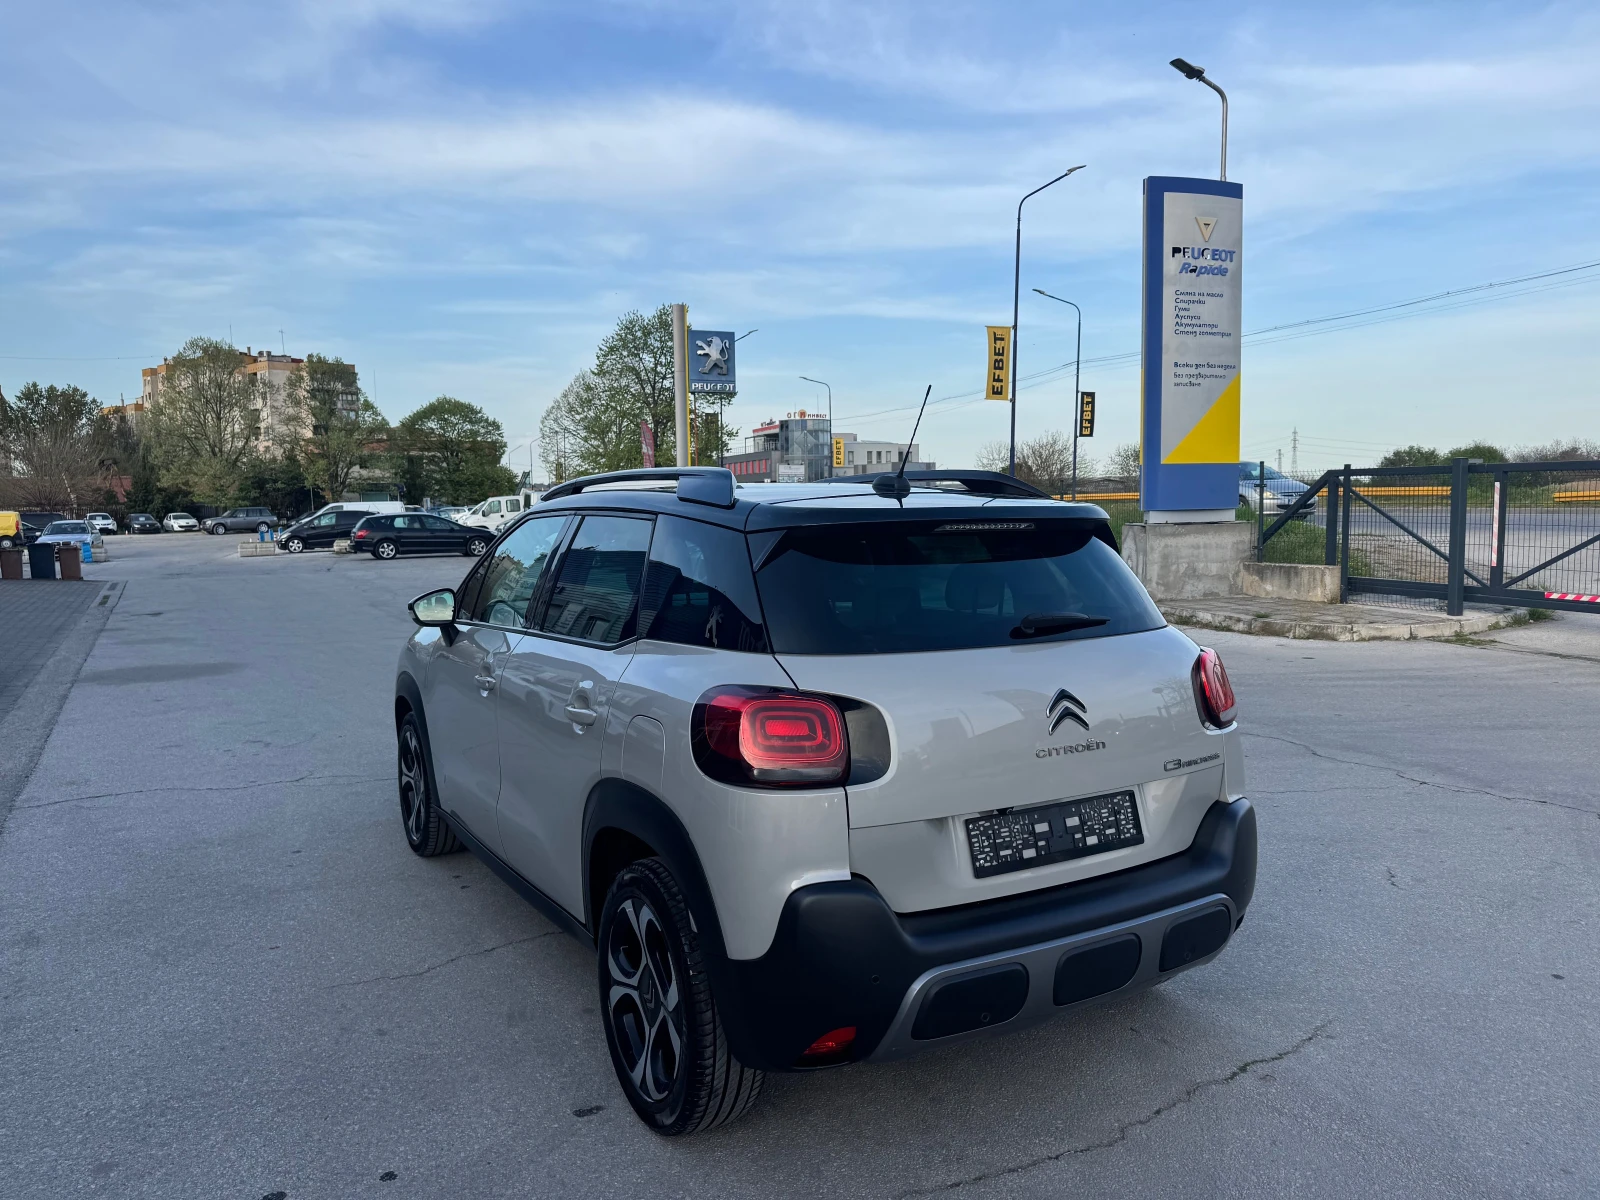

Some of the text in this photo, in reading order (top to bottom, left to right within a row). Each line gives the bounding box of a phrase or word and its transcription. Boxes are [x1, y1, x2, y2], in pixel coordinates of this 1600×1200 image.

[1171, 246, 1236, 262] PEUGEOT
[1178, 262, 1229, 277] Rapide
[1174, 289, 1197, 297] Смяна
[1174, 297, 1206, 305] Спирачки
[1174, 313, 1201, 321] Ауспуси
[1174, 321, 1219, 330] Акумулатори
[992, 331, 1005, 396] EFBET
[691, 382, 735, 391] PEUGEOT
[1082, 394, 1093, 435] EFBET
[1163, 758, 1182, 772] C3
